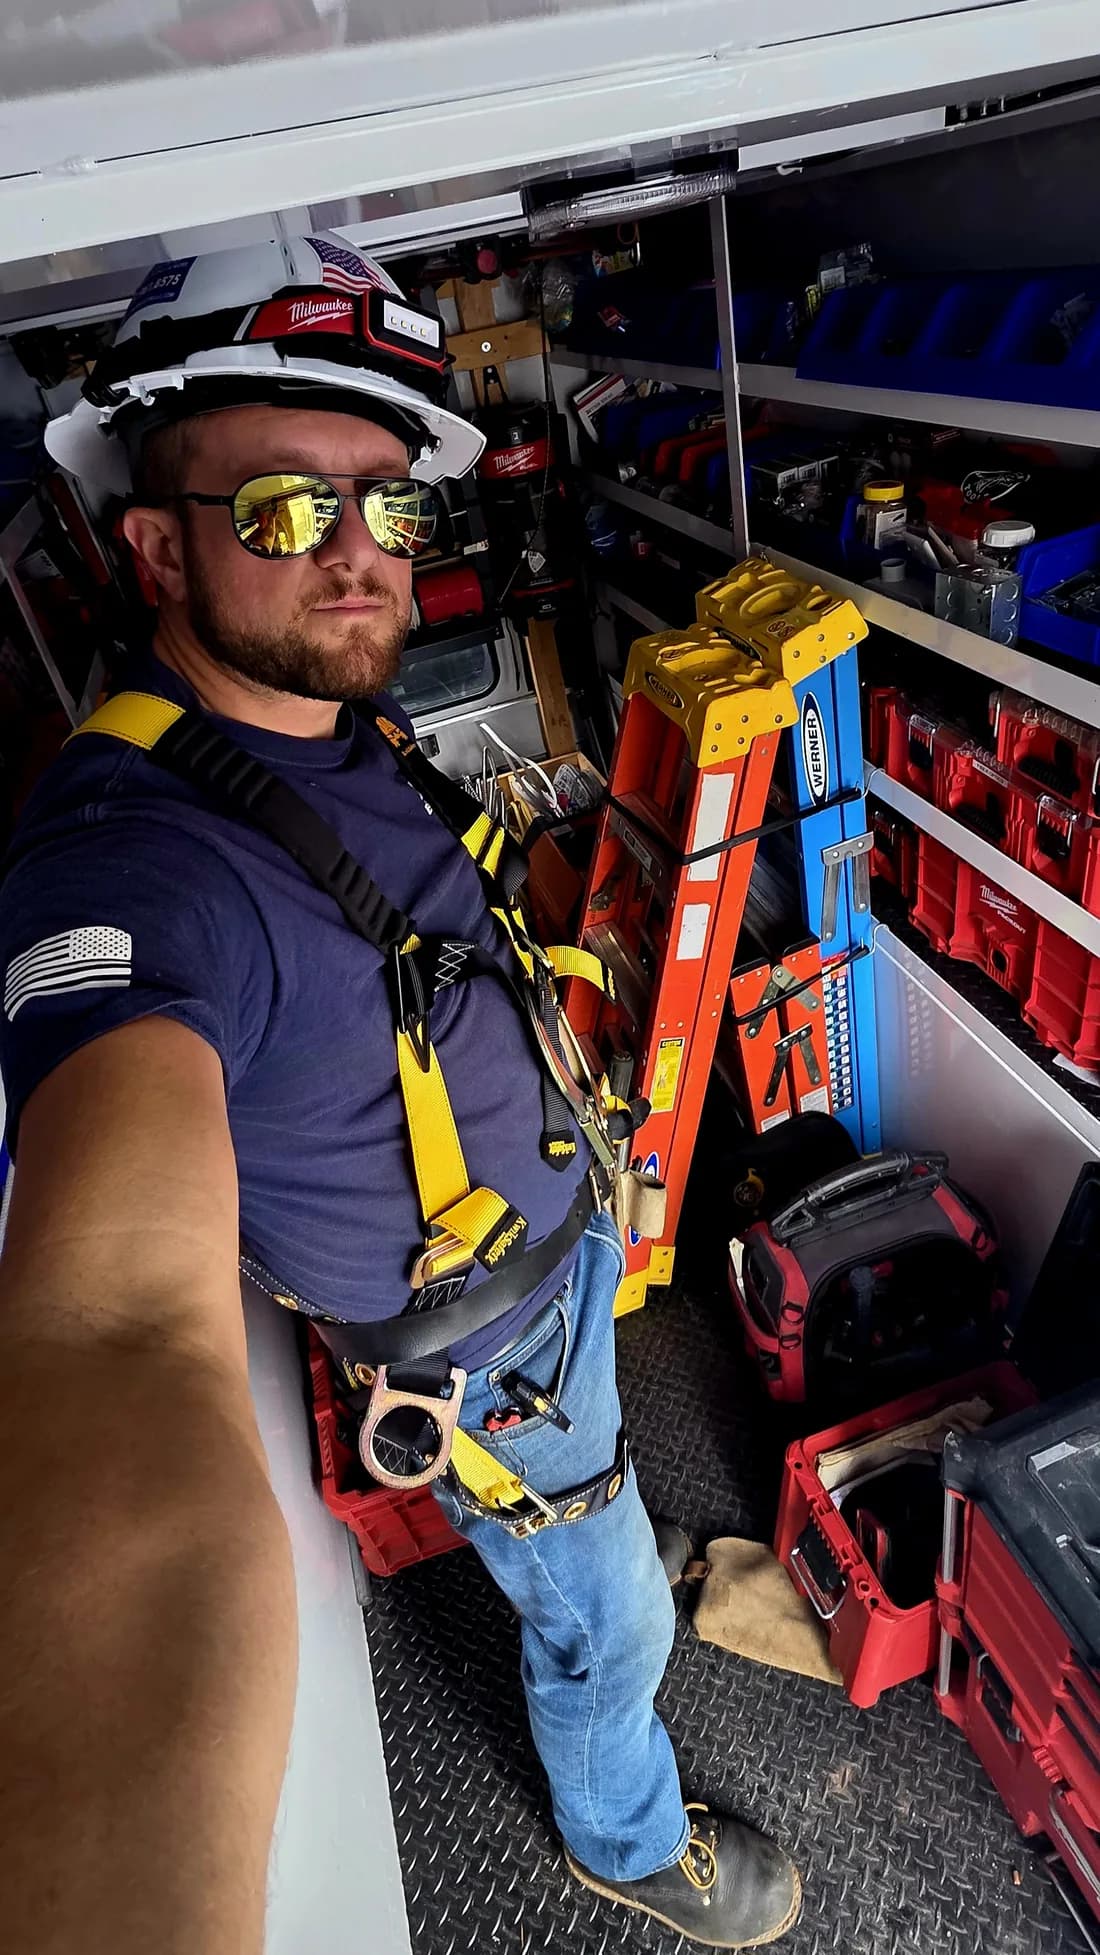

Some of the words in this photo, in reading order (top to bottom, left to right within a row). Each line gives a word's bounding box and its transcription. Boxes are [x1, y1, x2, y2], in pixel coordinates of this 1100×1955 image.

[287, 299, 354, 323] Milwaukee
[493, 446, 535, 470] Milwaukee
[807, 718, 823, 788] WERNER
[980, 884, 1017, 911] Milwaukee
[485, 1215, 527, 1265] KwikSafety
